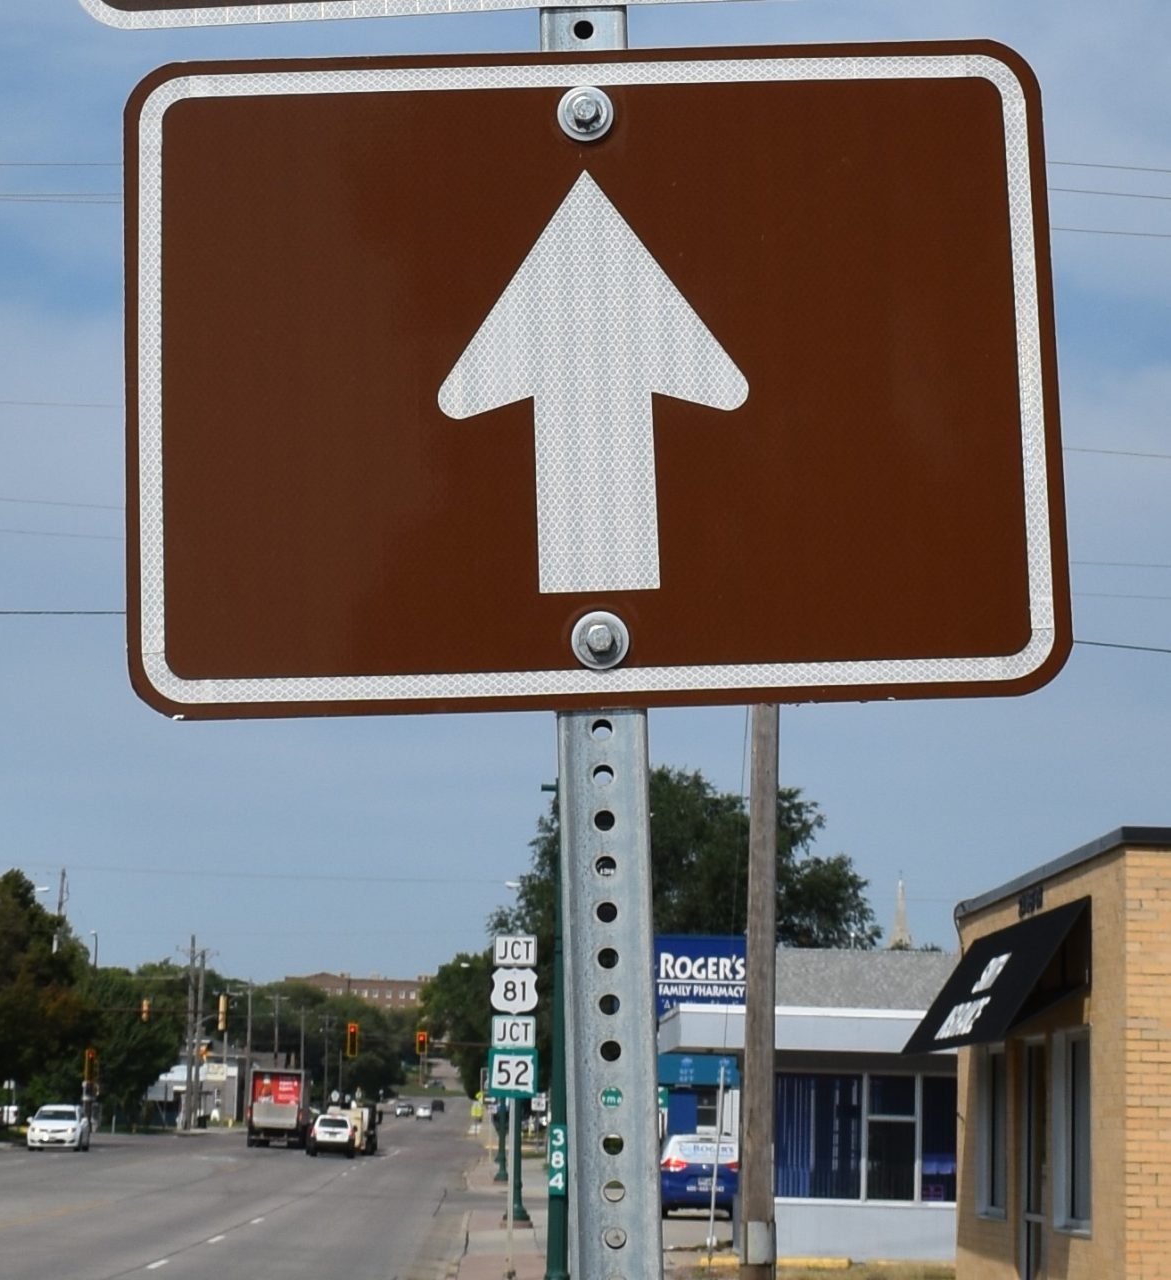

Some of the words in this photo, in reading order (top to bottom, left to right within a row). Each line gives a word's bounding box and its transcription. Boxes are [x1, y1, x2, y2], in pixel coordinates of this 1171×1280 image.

[498, 940, 533, 960] JCT
[659, 951, 746, 980] ROGER'S
[503, 980, 527, 1002] 81
[658, 984, 692, 996] FAMILY
[693, 984, 745, 998] PHARMACY
[497, 1022, 531, 1042] JCT
[497, 1060, 529, 1086] 52
